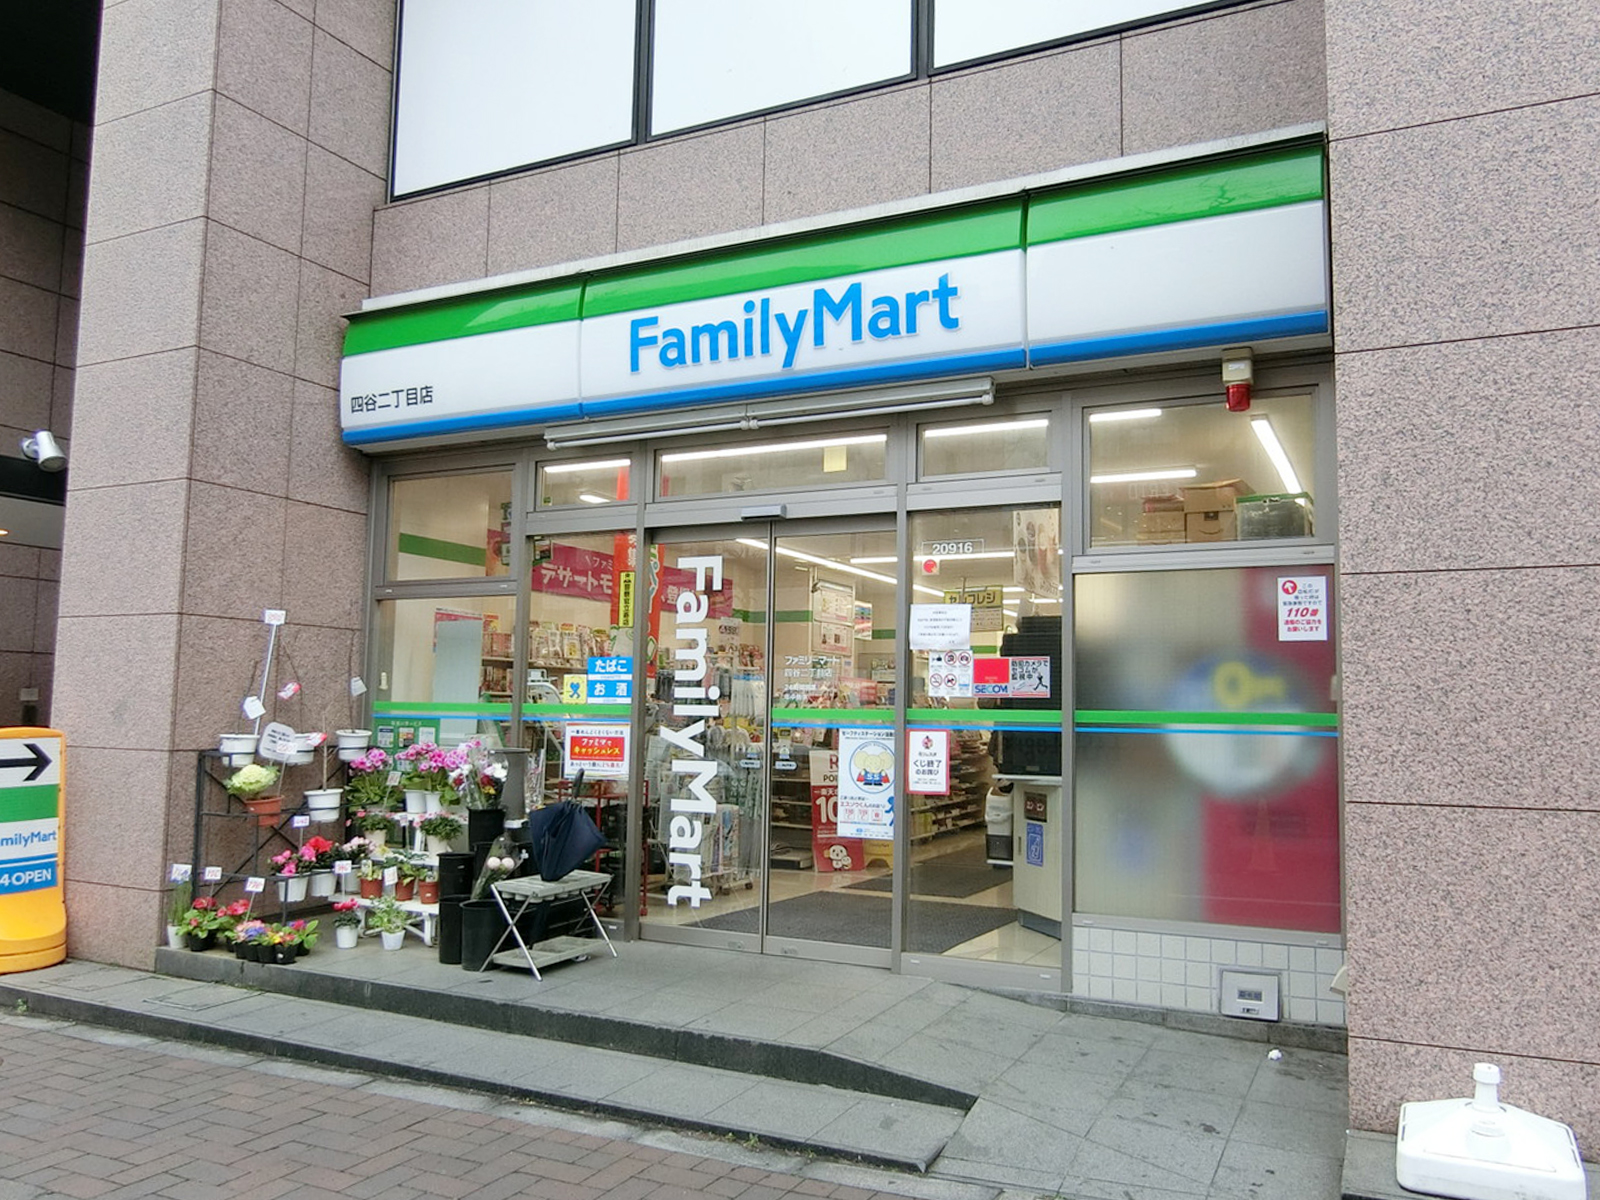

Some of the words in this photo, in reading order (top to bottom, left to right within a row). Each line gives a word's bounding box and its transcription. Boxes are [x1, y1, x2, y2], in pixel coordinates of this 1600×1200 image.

[629, 272, 960, 374] FamilyMart
[350, 384, 434, 414] 四谷二丁目店
[931, 541, 973, 555] 20916
[594, 659, 628, 673] たばこ
[784, 655, 840, 666] ファミリーマート
[974, 684, 1008, 694] SECOM
[659, 554, 724, 909] FamilyMart
[913, 759, 942, 768] くじ終了
[11, 868, 52, 886] OPEN
